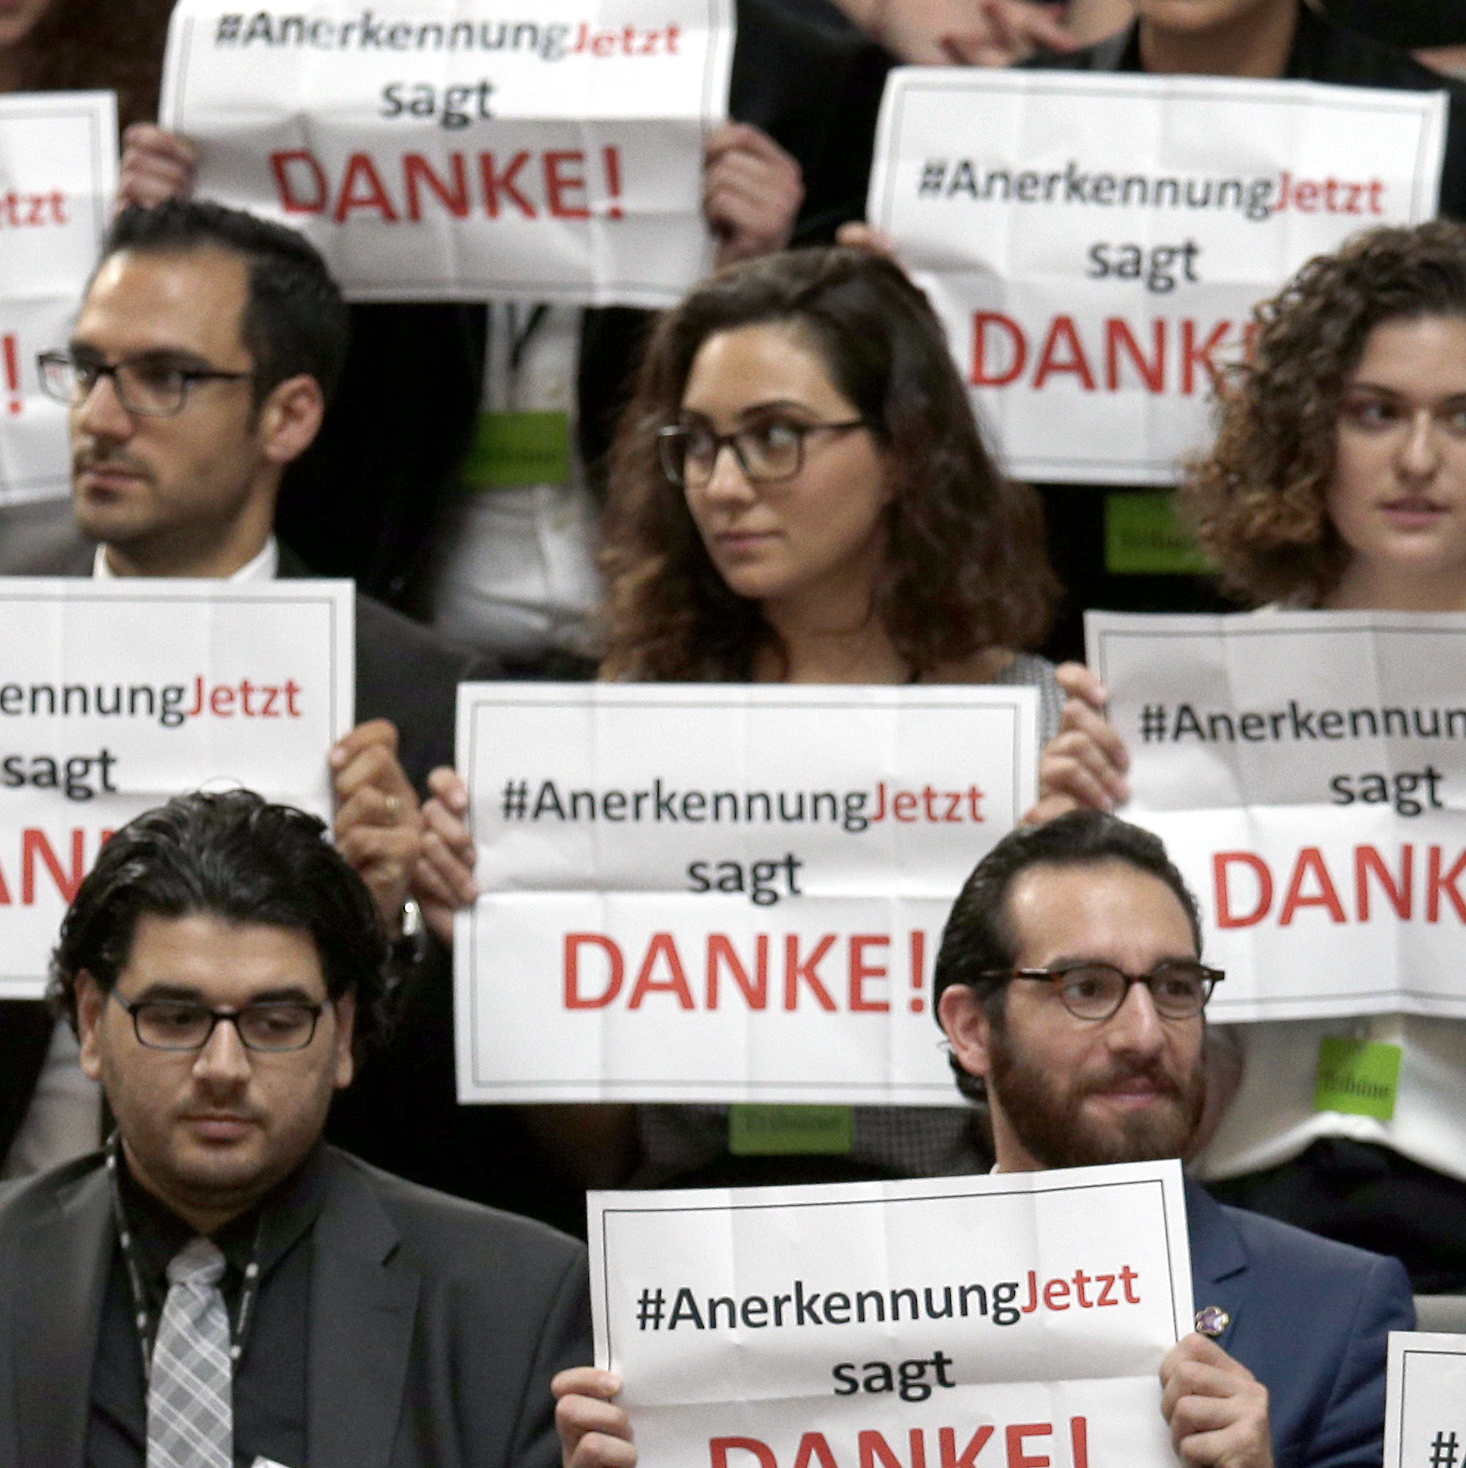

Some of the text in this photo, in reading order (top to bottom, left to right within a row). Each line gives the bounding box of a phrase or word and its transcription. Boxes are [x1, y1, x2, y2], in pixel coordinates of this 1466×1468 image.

[215, 7, 681, 60] #AnerkennungJetzt
[379, 74, 495, 128] sagt
[270, 145, 624, 222] DANKE!
[918, 159, 1385, 222] #AnerkennungJetzt
[1087, 239, 1200, 294] sagt
[970, 311, 1235, 396] DANK
[2, 747, 116, 803] sagt
[1332, 765, 1443, 819] sagt
[499, 778, 986, 834] #AnerkennungJetzt
[688, 852, 804, 909] sagt
[562, 929, 924, 1016] DANKE!
[635, 1265, 1141, 1332] #AnerkennungJetzt
[833, 1350, 955, 1400] sagt
